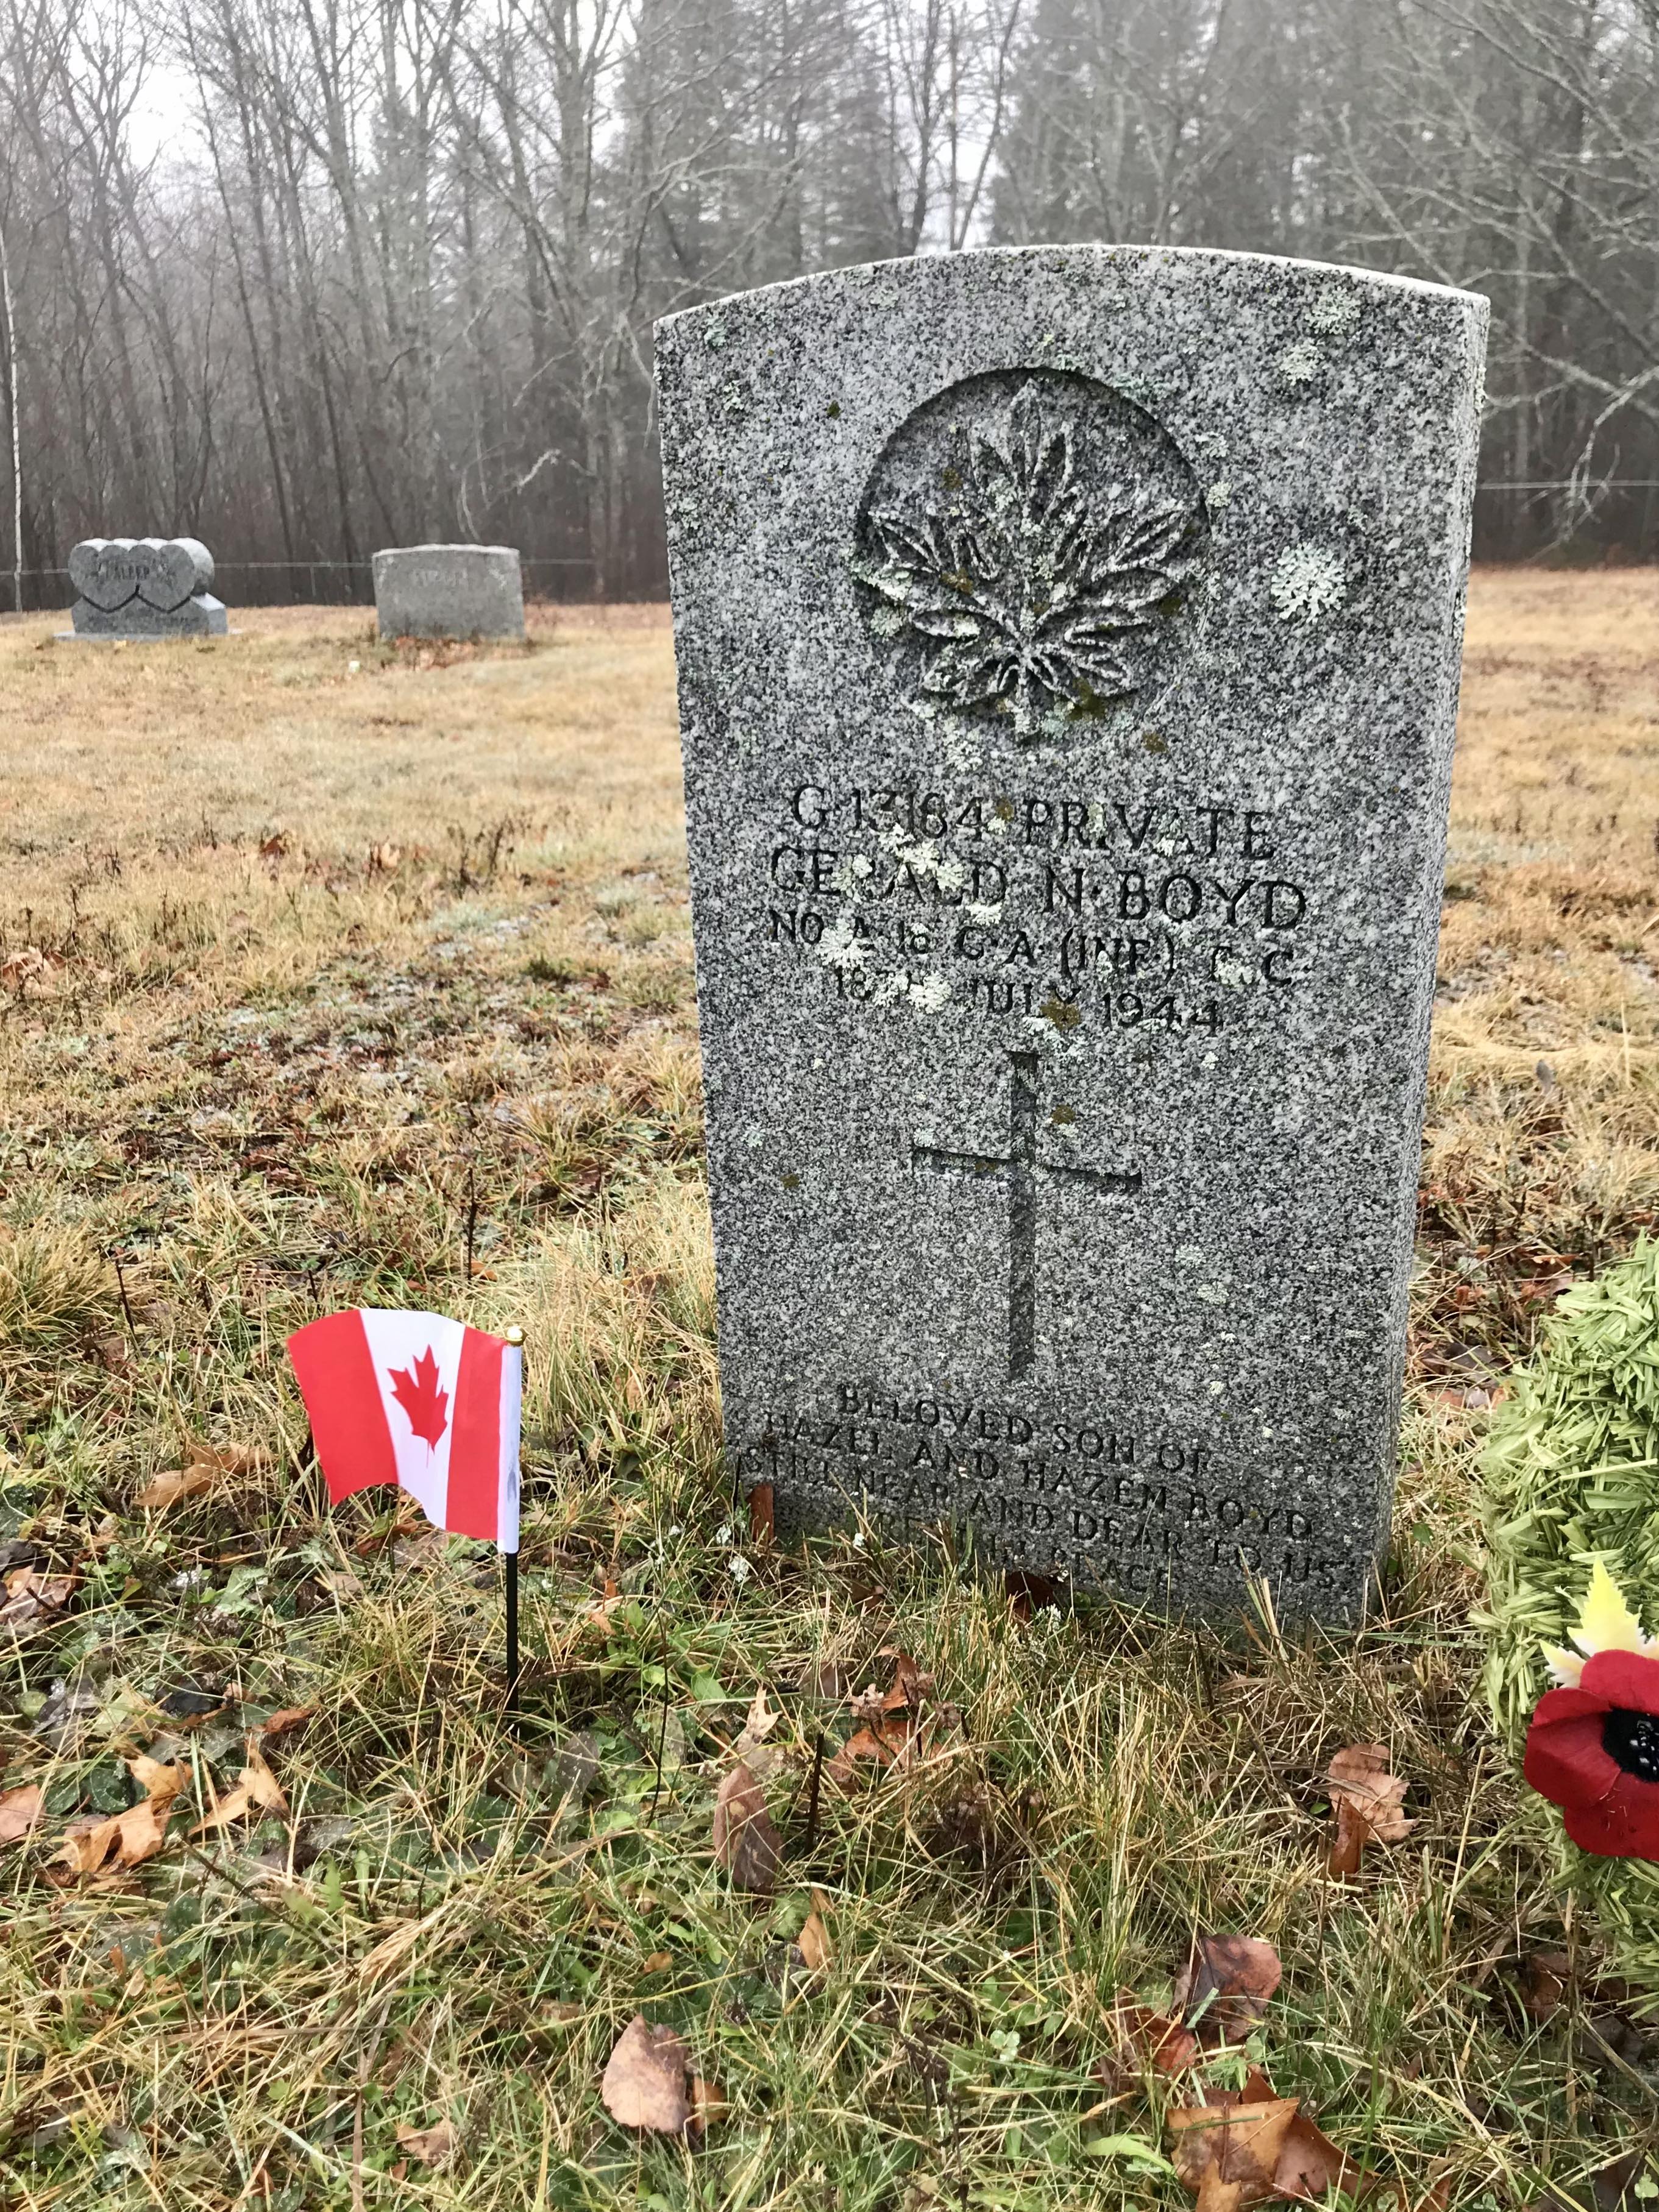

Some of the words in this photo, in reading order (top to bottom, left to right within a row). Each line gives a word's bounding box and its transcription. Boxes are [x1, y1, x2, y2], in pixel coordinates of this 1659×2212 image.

[1024, 799, 1276, 857] PRIVATE
[1117, 870, 1306, 930] BOYD
[1102, 993, 1221, 1032] 1944
[837, 1384, 1033, 1445] BELOVED
[1053, 1424, 1135, 1463] SON
[1160, 1442, 1209, 1476] OF
[763, 1411, 889, 1456] HAZEL
[914, 1439, 1000, 1481] AND
[1020, 1461, 1167, 1512] HAZEN
[1188, 1491, 1312, 1542] BOYD
[970, 1491, 1054, 1530] AND
[1072, 1509, 1185, 1560] DEAR
[1202, 1535, 1262, 1575] TO
